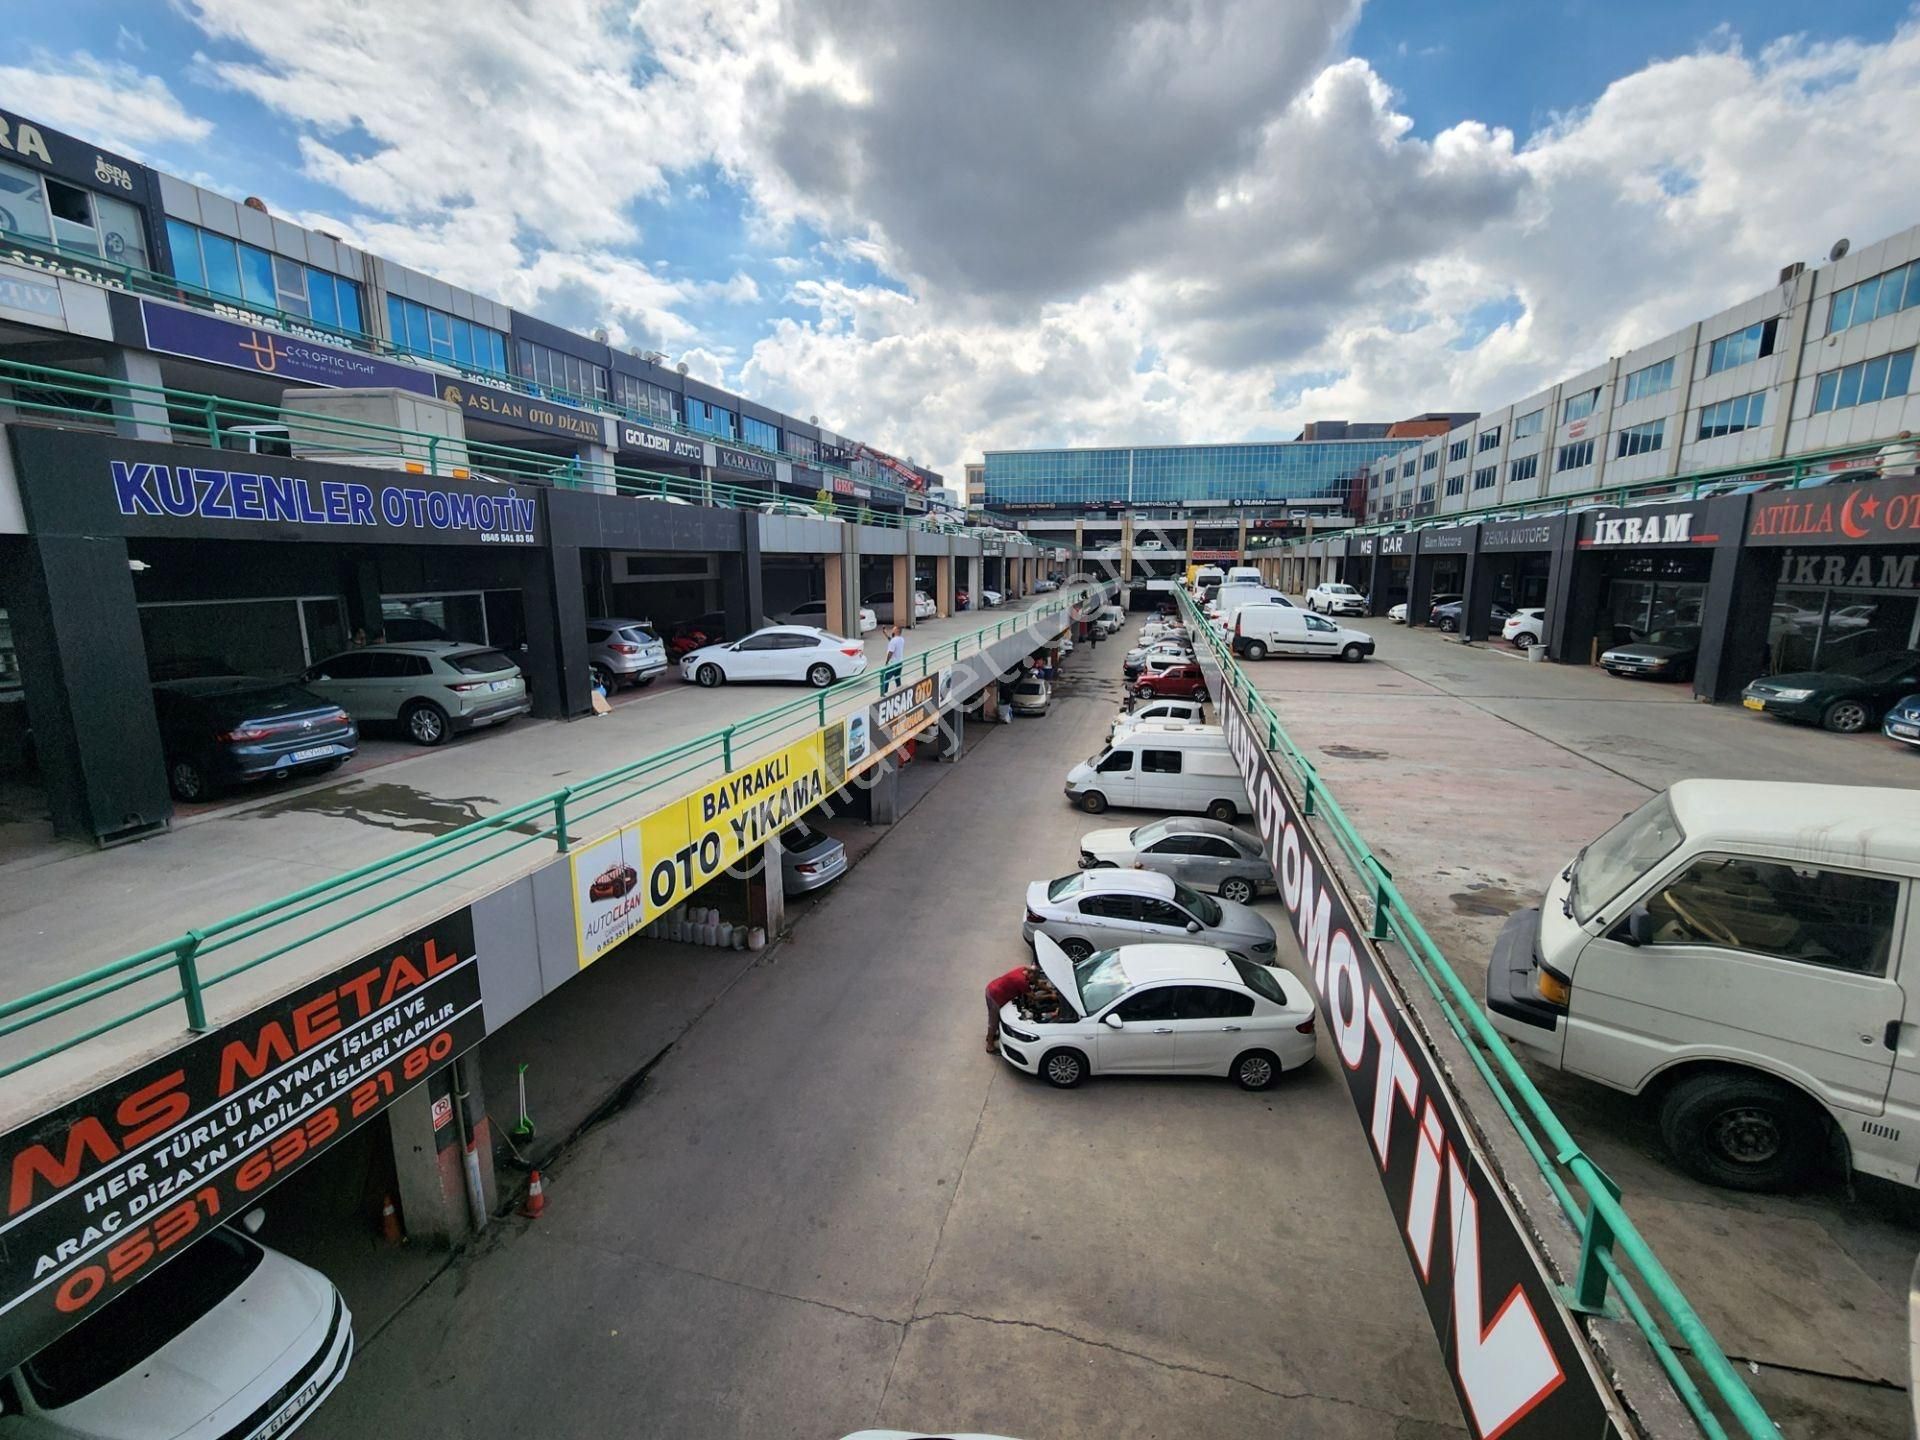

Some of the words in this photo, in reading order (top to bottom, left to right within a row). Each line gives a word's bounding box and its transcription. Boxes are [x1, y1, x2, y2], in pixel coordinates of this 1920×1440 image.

[95, 167, 133, 191] OTO
[312, 352, 345, 368] OPTIC
[468, 394, 523, 418] ASLAN
[529, 408, 554, 425] OTO
[558, 413, 598, 436] DİZAYN
[625, 428, 670, 452] GOLDEN
[674, 441, 701, 459] AUTO
[723, 451, 774, 476] KARAKAYA
[110, 460, 377, 526] KUZENLER
[381, 487, 535, 532] OTOMOTİV
[1751, 497, 1833, 536] ATİLLA
[1360, 540, 1373, 554] MS
[1382, 536, 1402, 553] CAR
[1510, 526, 1550, 545] MOTORS
[1593, 511, 1694, 546] İKRAM
[1778, 549, 1919, 588] İKRAM
[878, 688, 914, 726] ENSAR
[915, 678, 933, 705] OTO
[703, 754, 790, 823] BAYRAKLI
[650, 831, 721, 908] OTO
[730, 769, 823, 853] YIKAMA
[9, 1067, 190, 1216] MS
[218, 938, 458, 1097] METAL
[84, 1160, 149, 1215] HER
[153, 1100, 243, 1171] TÜRLÜ
[248, 1049, 339, 1124] KAYNAK
[340, 1006, 403, 1059] İŞLERİ
[403, 996, 426, 1019] VE
[1258, 767, 1566, 1439] OTOMOTİV
[33, 1210, 123, 1280] ARAÇ
[129, 1144, 228, 1213] DİZAYN
[232, 1086, 325, 1150] TADİLAT
[329, 1039, 390, 1093] İŞLERİ
[391, 1002, 455, 1051] YAPILIR
[54, 1187, 220, 1313] 0531
[235, 1105, 340, 1193] 633
[351, 1070, 395, 1119] 21
[403, 1031, 454, 1081] 80
